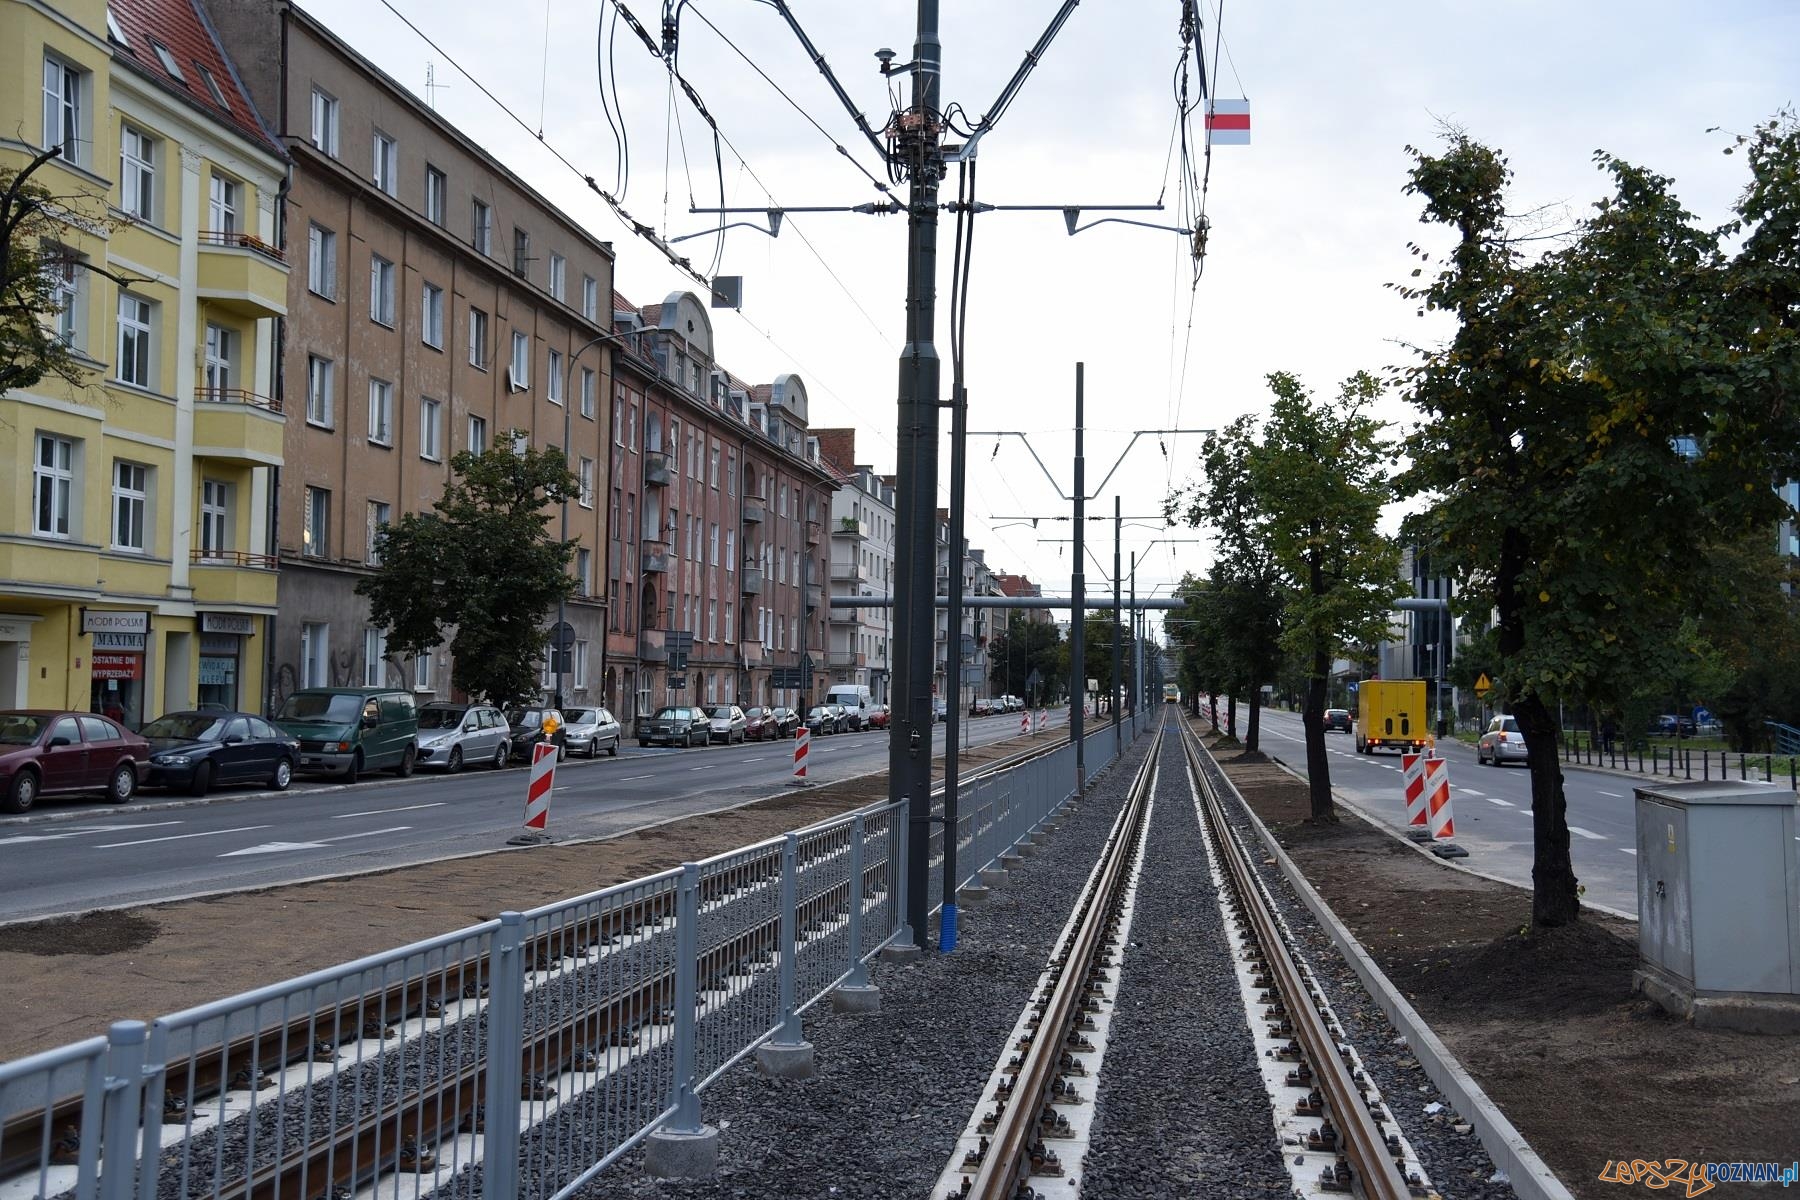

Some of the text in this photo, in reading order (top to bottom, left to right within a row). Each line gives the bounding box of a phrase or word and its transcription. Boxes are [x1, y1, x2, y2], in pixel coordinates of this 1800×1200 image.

[87, 617, 144, 627] MODA POLSKA
[97, 633, 143, 647] MAXIMA
[92, 656, 136, 665] OSTATNIE DNI
